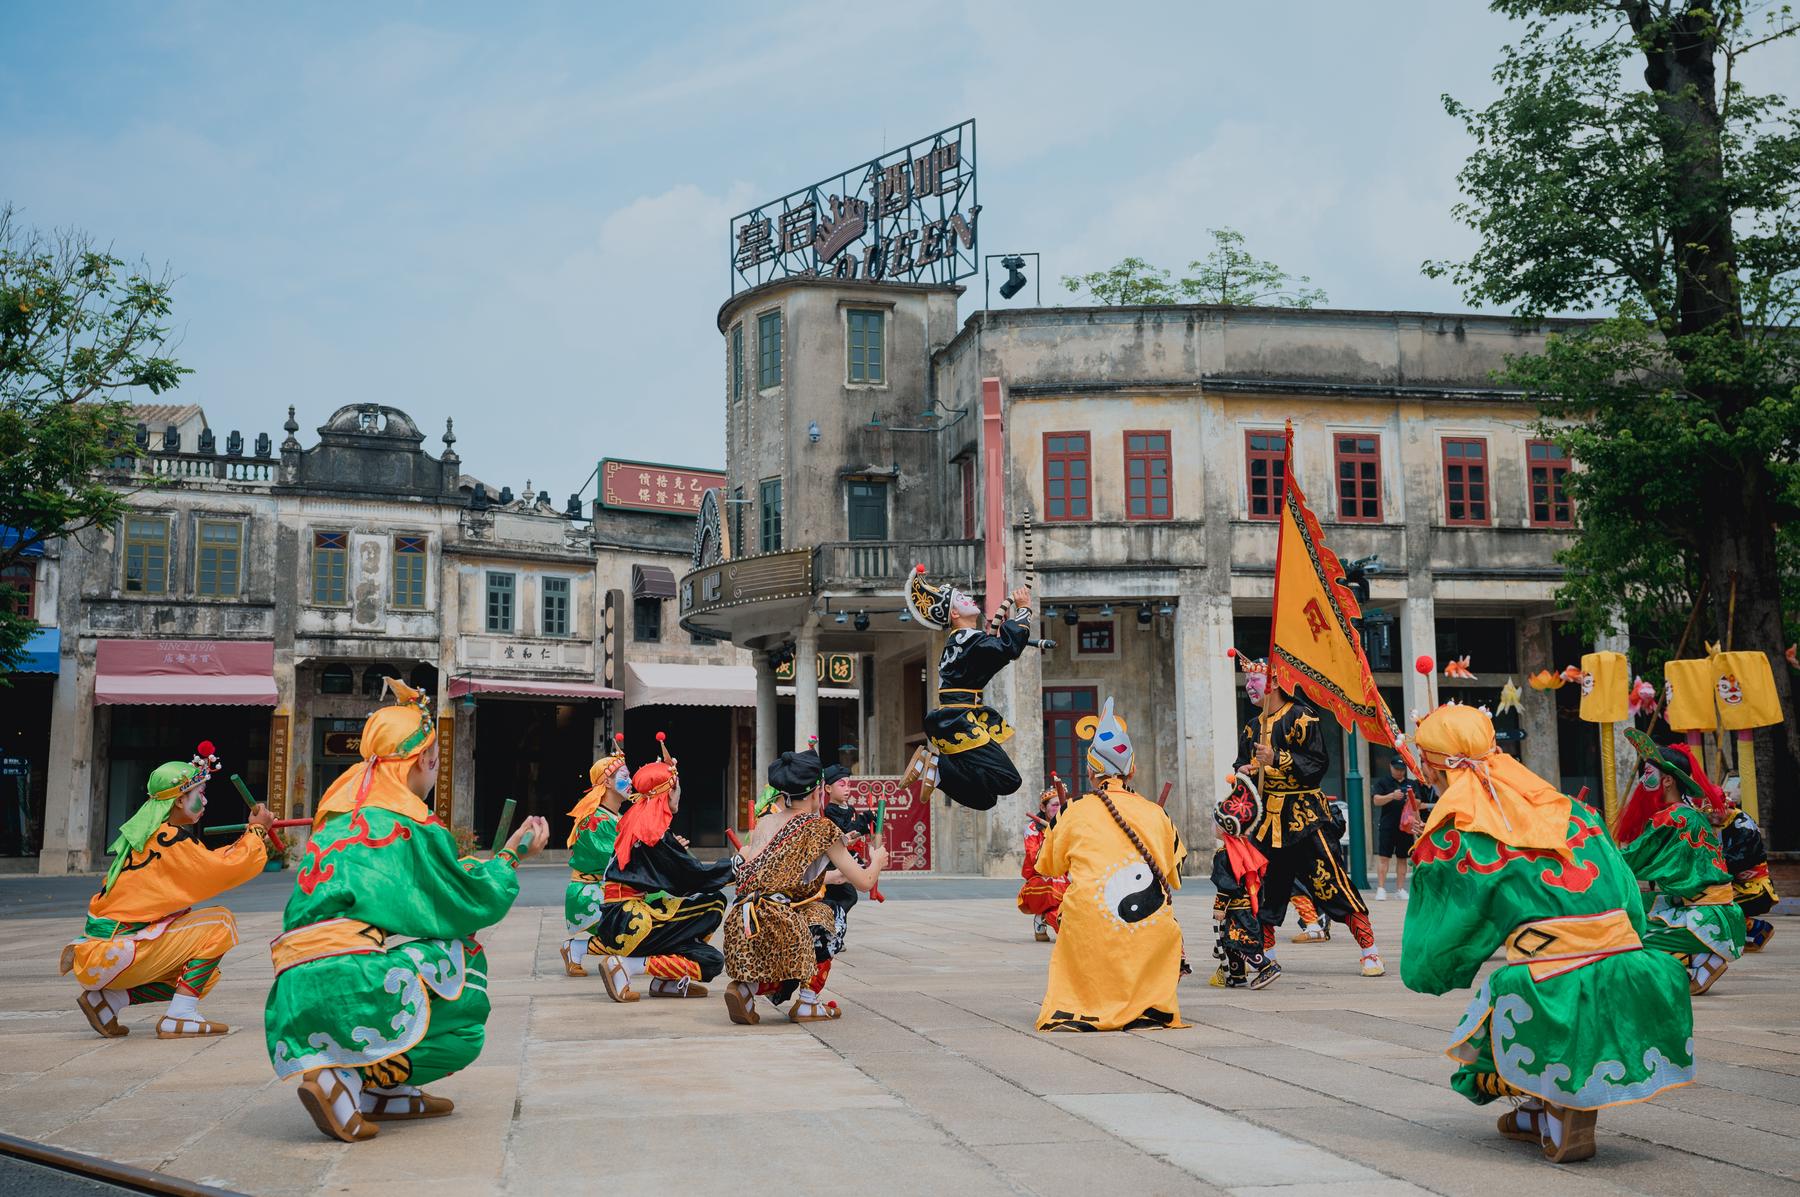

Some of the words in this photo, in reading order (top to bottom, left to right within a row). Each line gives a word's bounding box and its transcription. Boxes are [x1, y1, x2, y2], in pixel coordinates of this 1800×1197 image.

[735, 199, 817, 272] 皇后
[868, 141, 962, 220] 酒吧
[159, 642, 192, 651] SINCE
